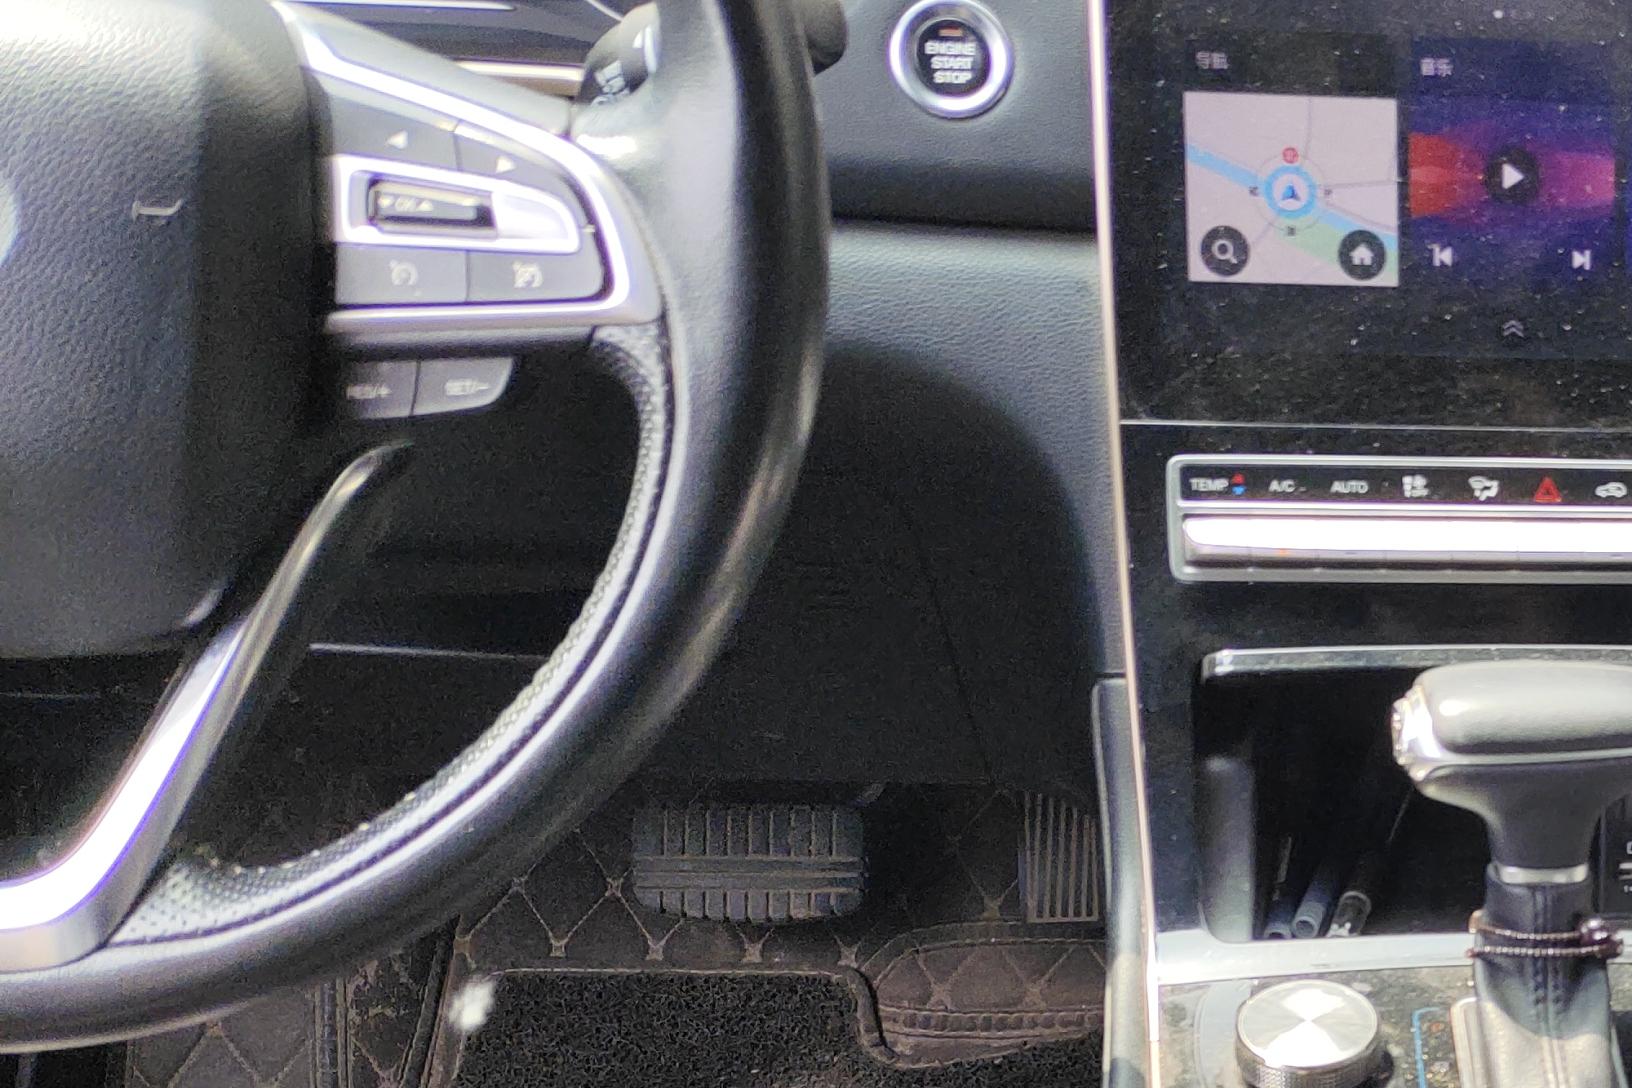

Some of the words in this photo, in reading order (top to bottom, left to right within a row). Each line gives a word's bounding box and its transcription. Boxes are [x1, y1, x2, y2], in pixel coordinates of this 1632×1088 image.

[924, 40, 976, 55] ENGINE
[930, 56, 974, 69] START
[1420, 58, 1453, 76] 音乐
[933, 70, 971, 84] STOP
[1189, 478, 1229, 491] TEMP
[1268, 479, 1295, 492] A/C
[1330, 480, 1368, 494] AUTO
